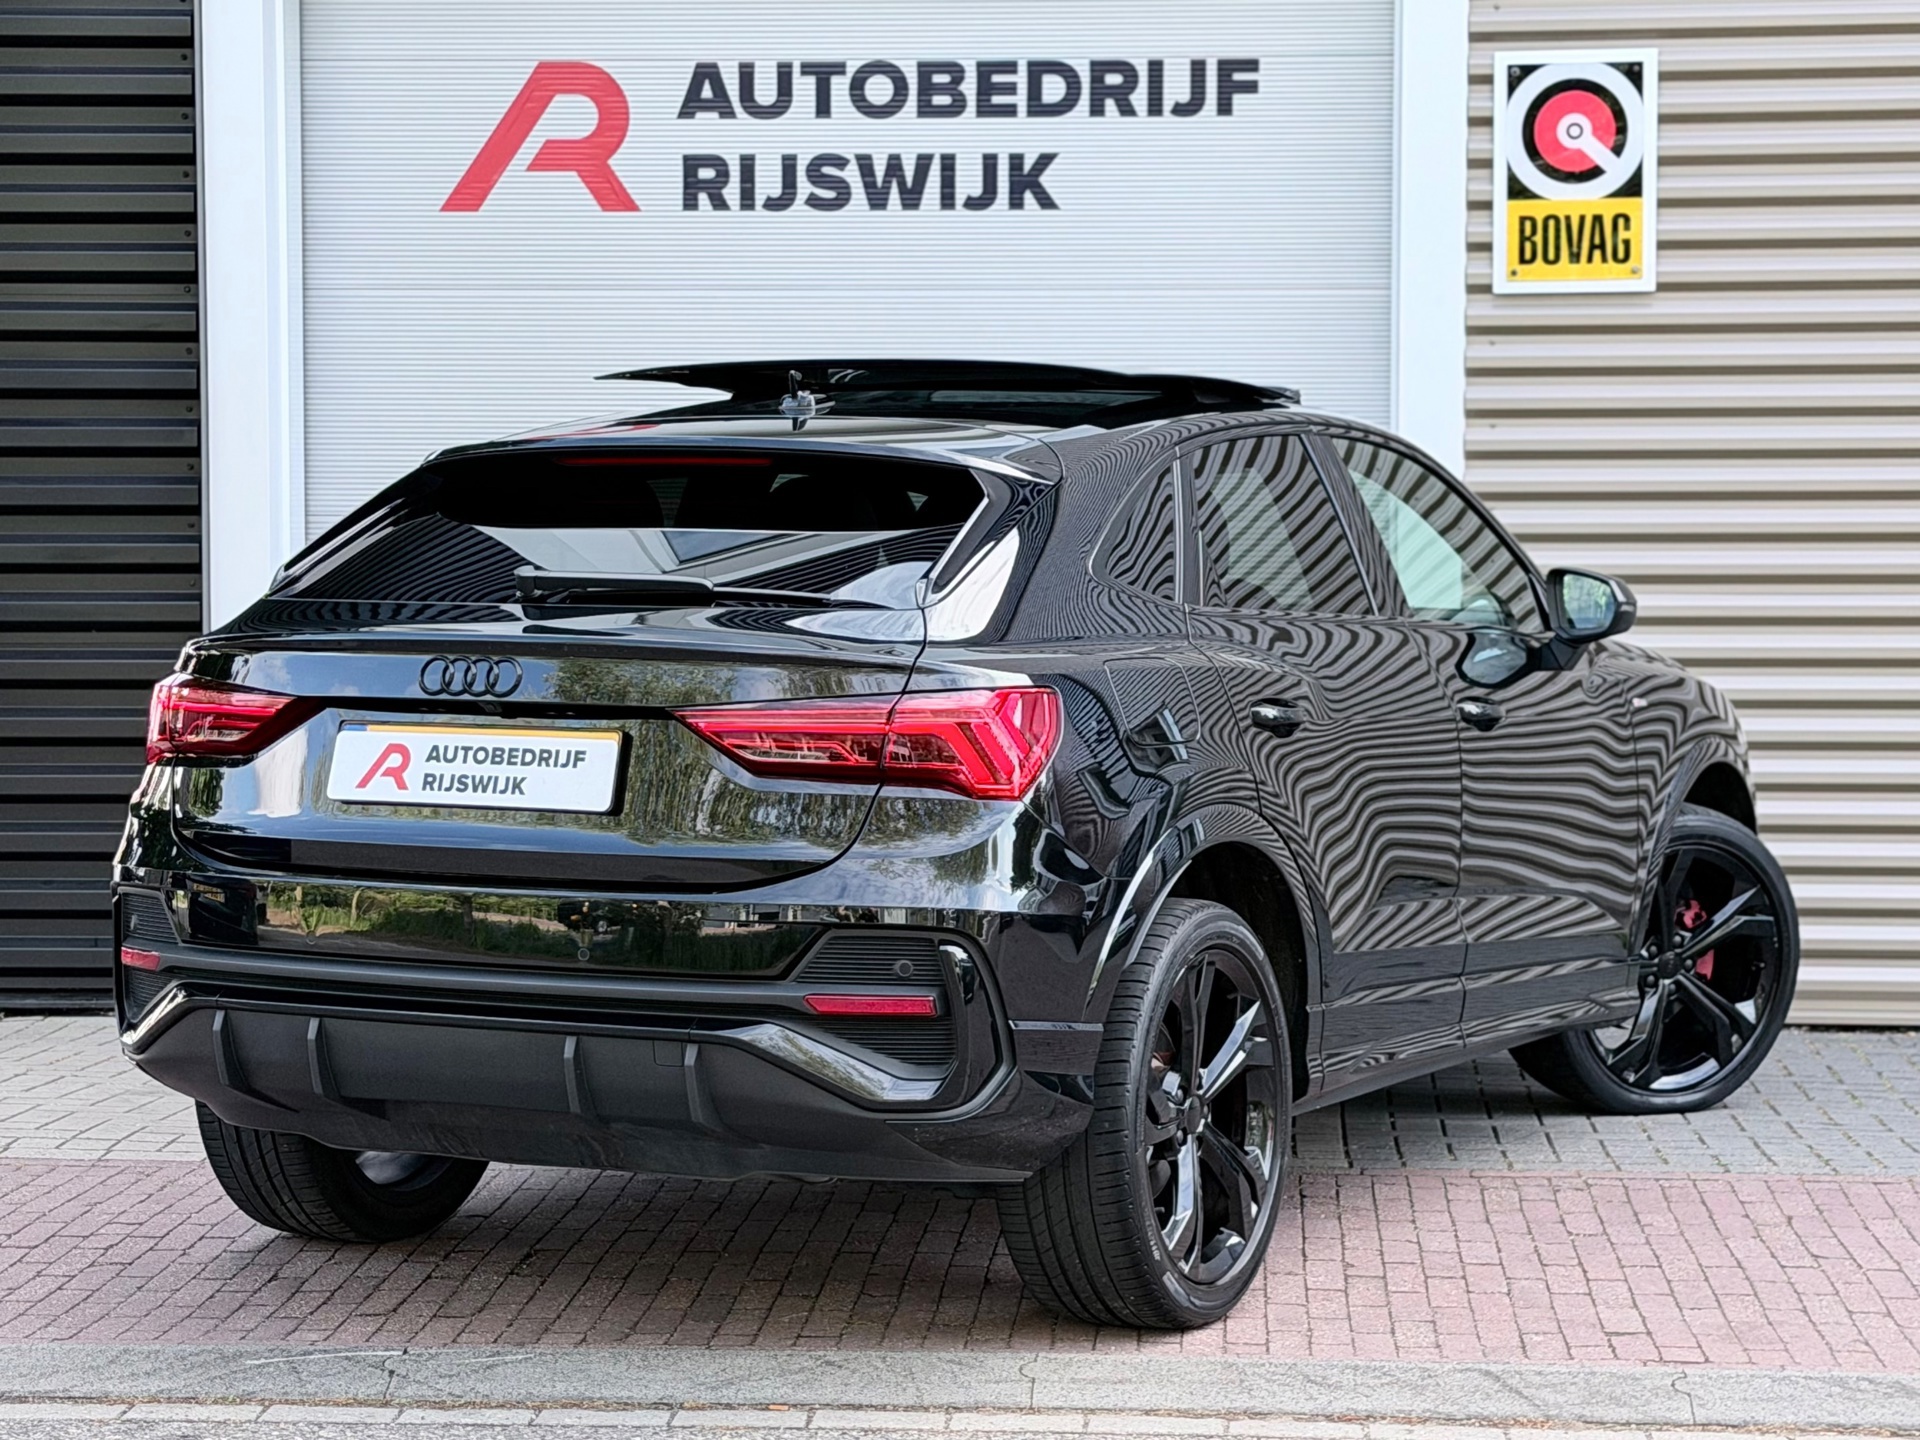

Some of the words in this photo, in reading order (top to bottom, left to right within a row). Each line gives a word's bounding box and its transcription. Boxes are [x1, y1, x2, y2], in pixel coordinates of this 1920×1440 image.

[677, 58, 1260, 120] AUTOBEDRIJF
[682, 152, 1060, 212] RIJSWIJK
[1518, 213, 1631, 265] BOVAG
[424, 744, 588, 769] AUTOBEDRIJF
[421, 772, 528, 796] RIJSWIJK
